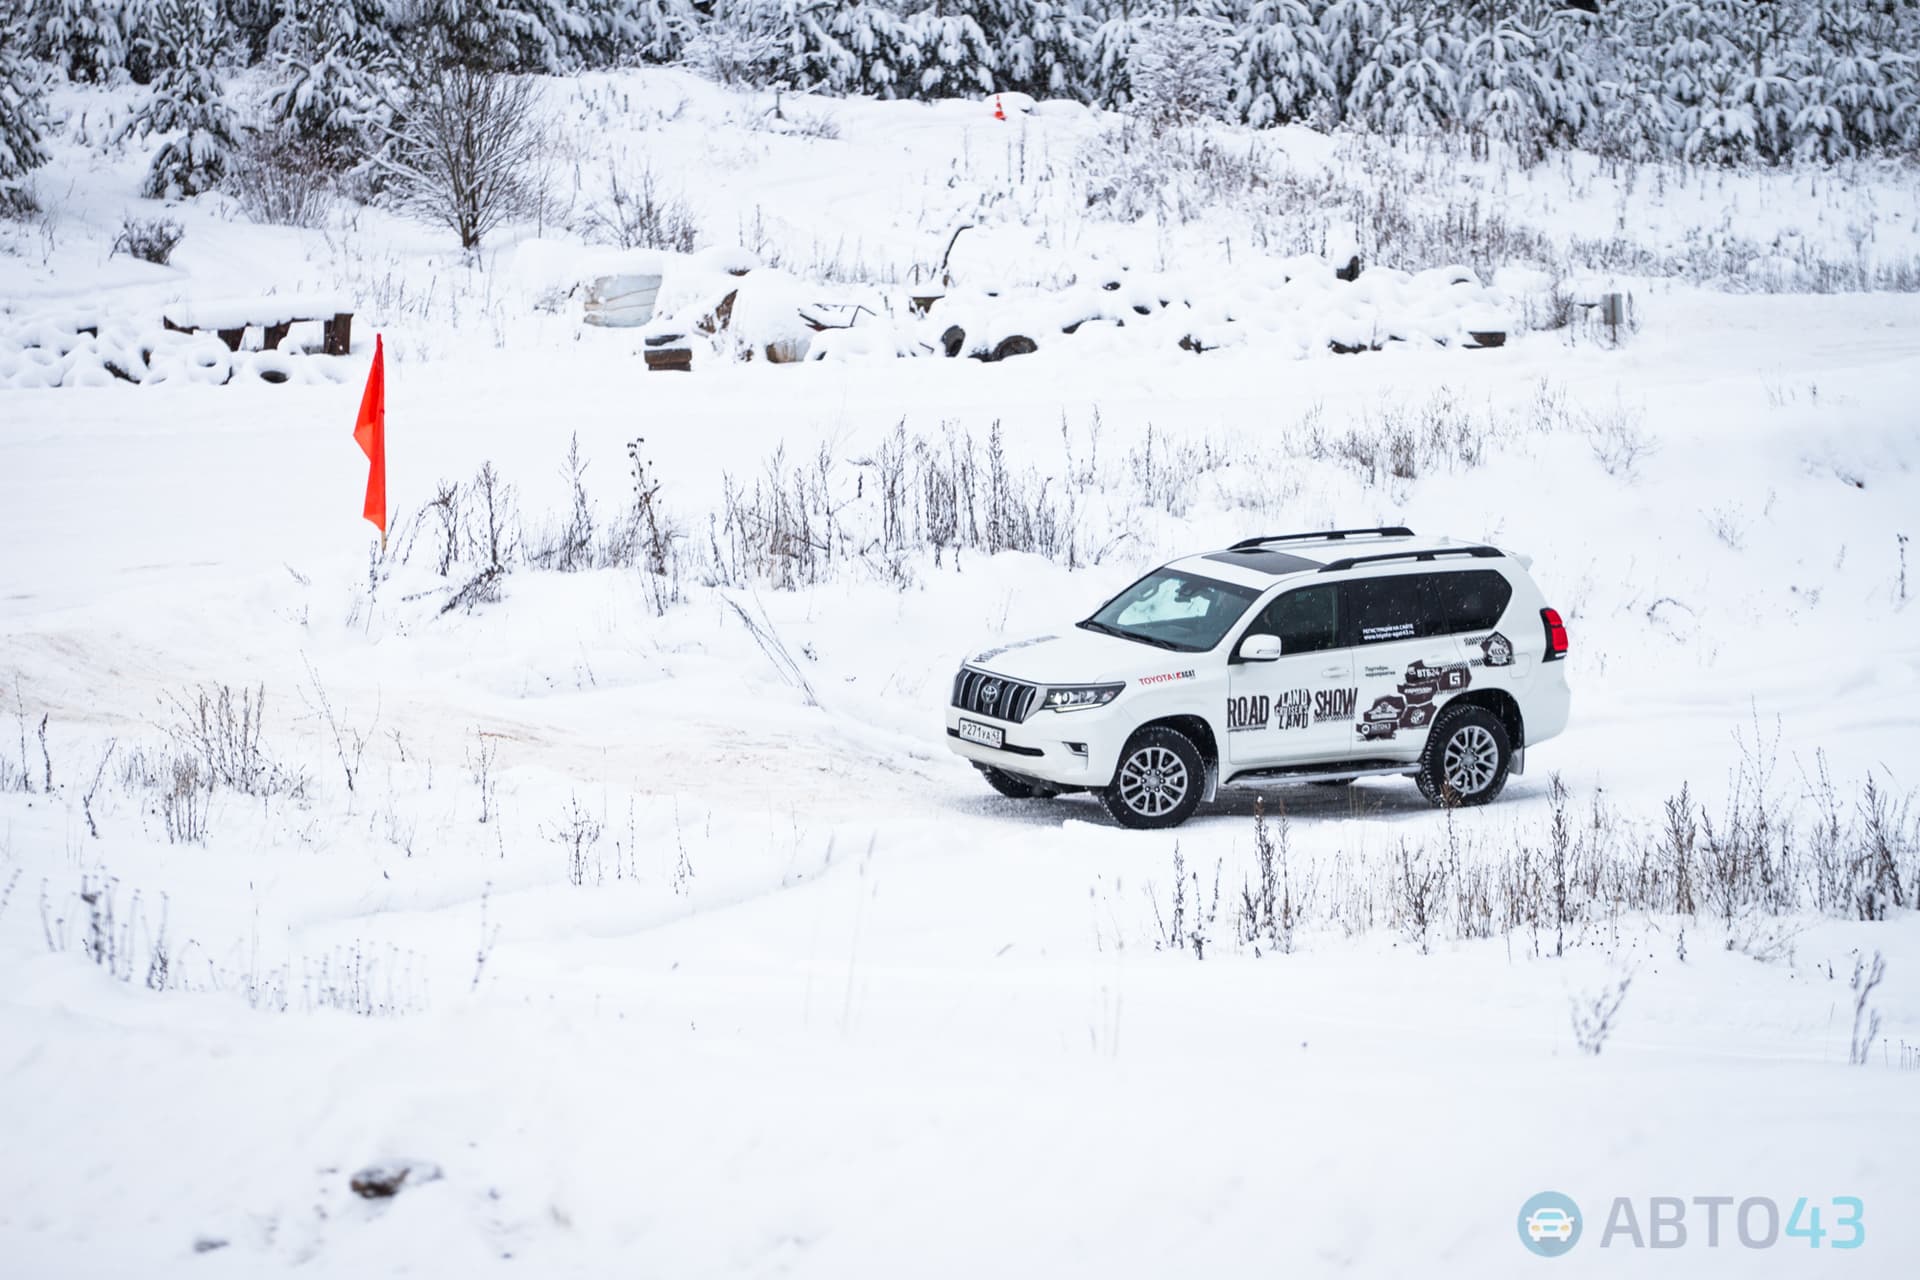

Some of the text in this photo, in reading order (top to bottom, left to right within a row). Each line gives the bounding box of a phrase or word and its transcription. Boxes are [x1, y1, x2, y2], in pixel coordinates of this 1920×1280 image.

[1138, 673, 1173, 686] TOYOTA
[1280, 688, 1309, 706] LAND
[1313, 687, 1358, 719] SHOW
[1226, 695, 1270, 729] ROAD
[1278, 713, 1309, 730] LAND
